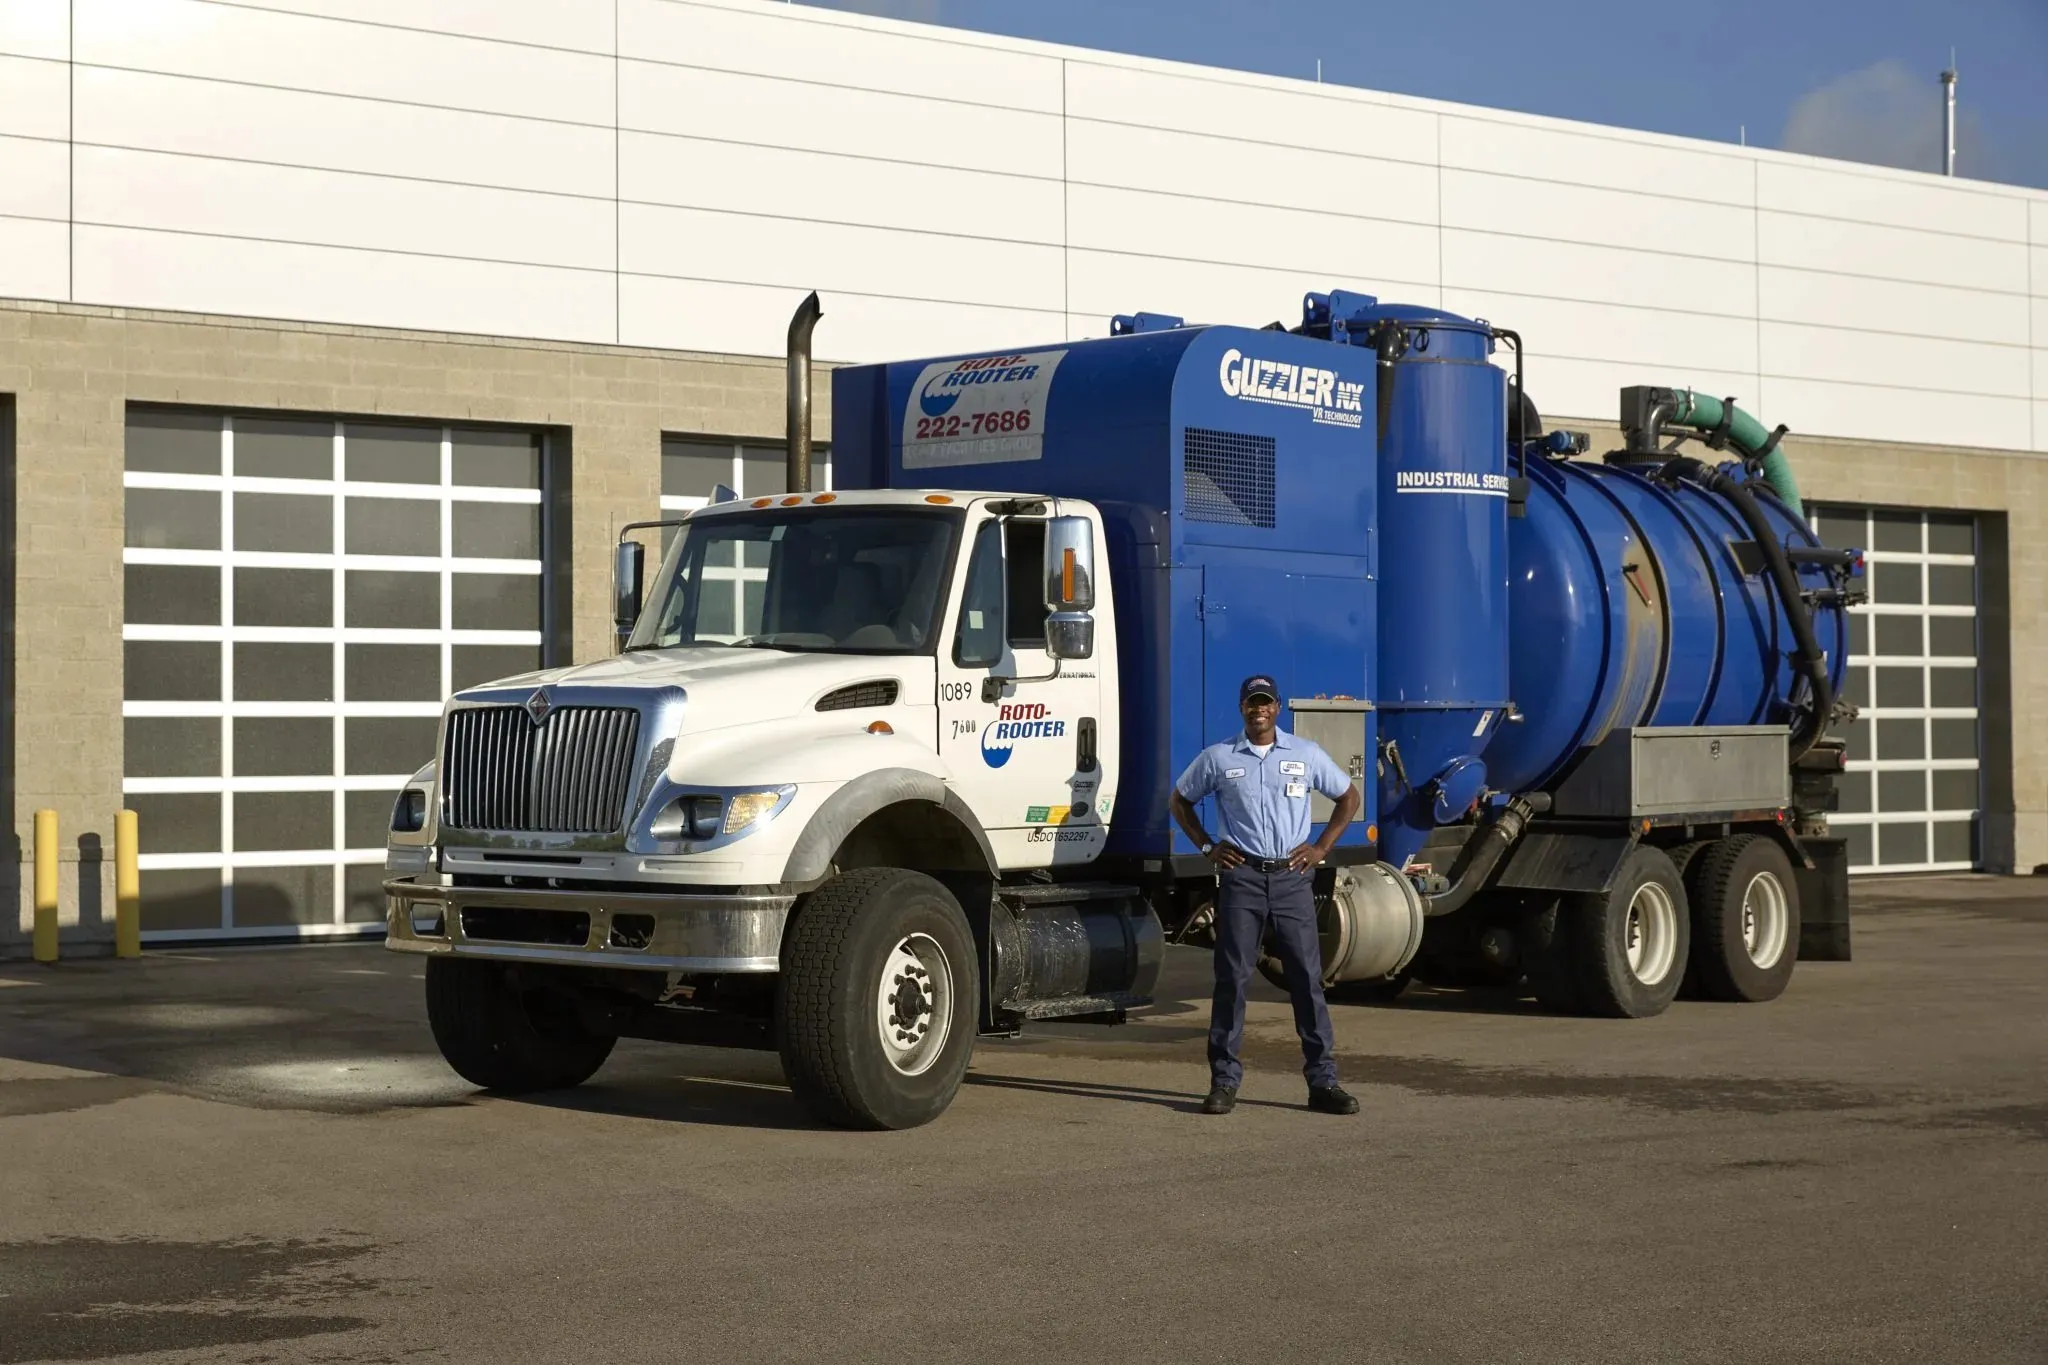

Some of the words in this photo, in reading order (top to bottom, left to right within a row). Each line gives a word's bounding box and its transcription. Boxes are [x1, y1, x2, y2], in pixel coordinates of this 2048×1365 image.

[954, 355, 1027, 372] ROTO-
[942, 365, 1040, 387] ROOTER
[1220, 349, 1334, 407] GUZZLER
[1336, 382, 1365, 411] NX
[916, 410, 1031, 439] 222-7686
[1313, 407, 1323, 419] VR
[1324, 410, 1363, 425] TECHNOLOGY
[1397, 471, 1480, 488] INDUSTRIAL
[940, 682, 972, 701] 1089
[999, 703, 1051, 721] ROTO-
[952, 719, 976, 740] 7600
[996, 721, 1065, 739] ROOTER
[1027, 831, 1090, 843] USDOT652297
